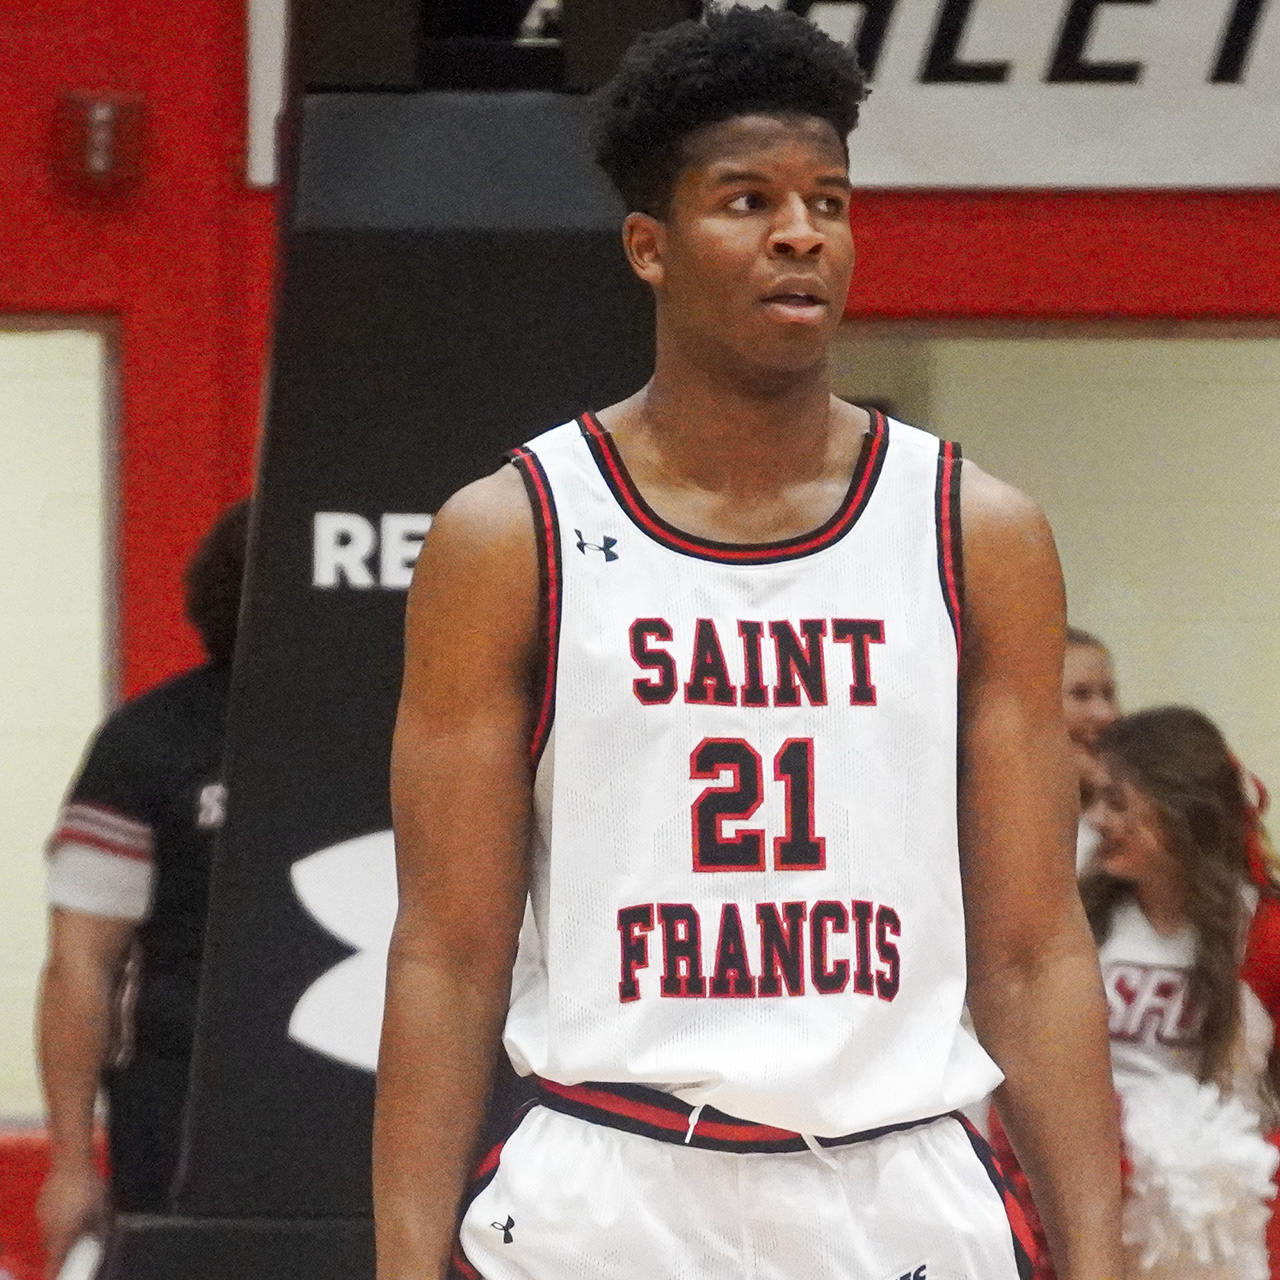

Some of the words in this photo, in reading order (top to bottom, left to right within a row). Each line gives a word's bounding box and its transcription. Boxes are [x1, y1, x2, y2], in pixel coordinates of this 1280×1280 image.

[629, 618, 885, 707] SAINT
[689, 737, 827, 873] 21
[617, 900, 902, 1004] FRANCIS
